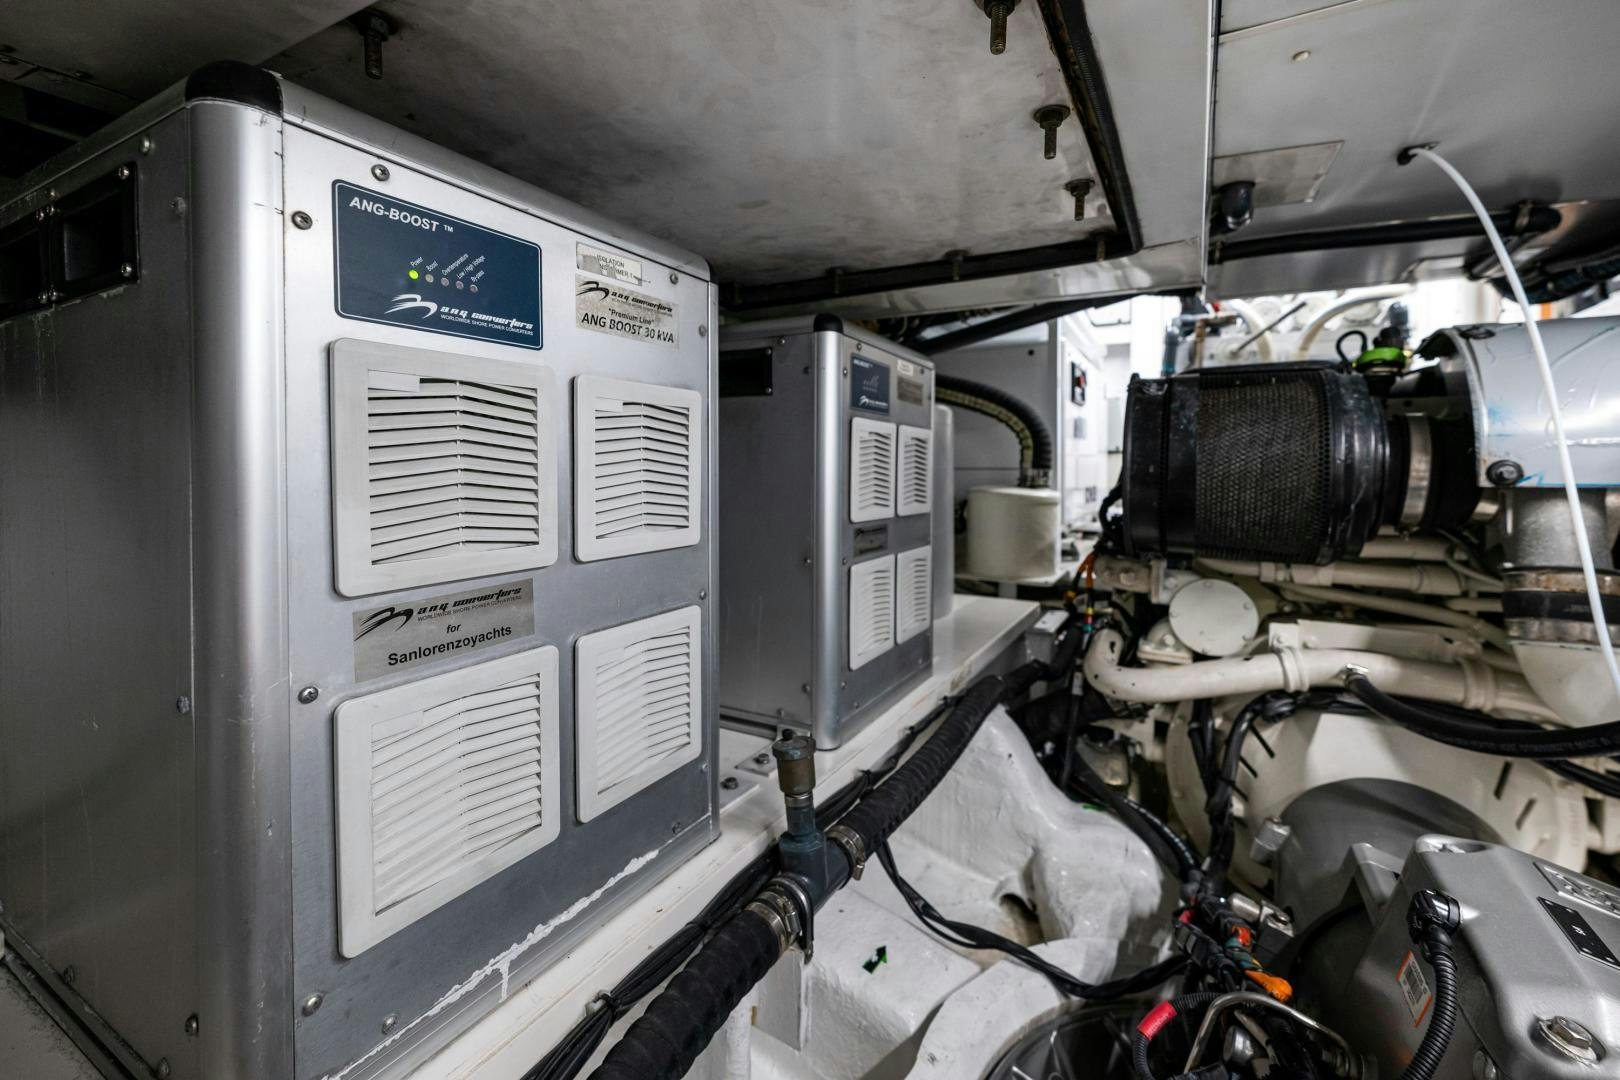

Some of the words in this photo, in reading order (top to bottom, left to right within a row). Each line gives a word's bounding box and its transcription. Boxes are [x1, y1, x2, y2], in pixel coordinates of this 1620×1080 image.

[349, 196, 440, 232] ANG-BOOST
[410, 256, 424, 267] Power
[581, 312, 607, 328] ANG
[609, 318, 643, 336] BOOST
[643, 327, 656, 340] 30
[656, 330, 674, 344] kVA
[446, 622, 461, 636] for
[387, 625, 513, 667] Sanlorenzoyachts
